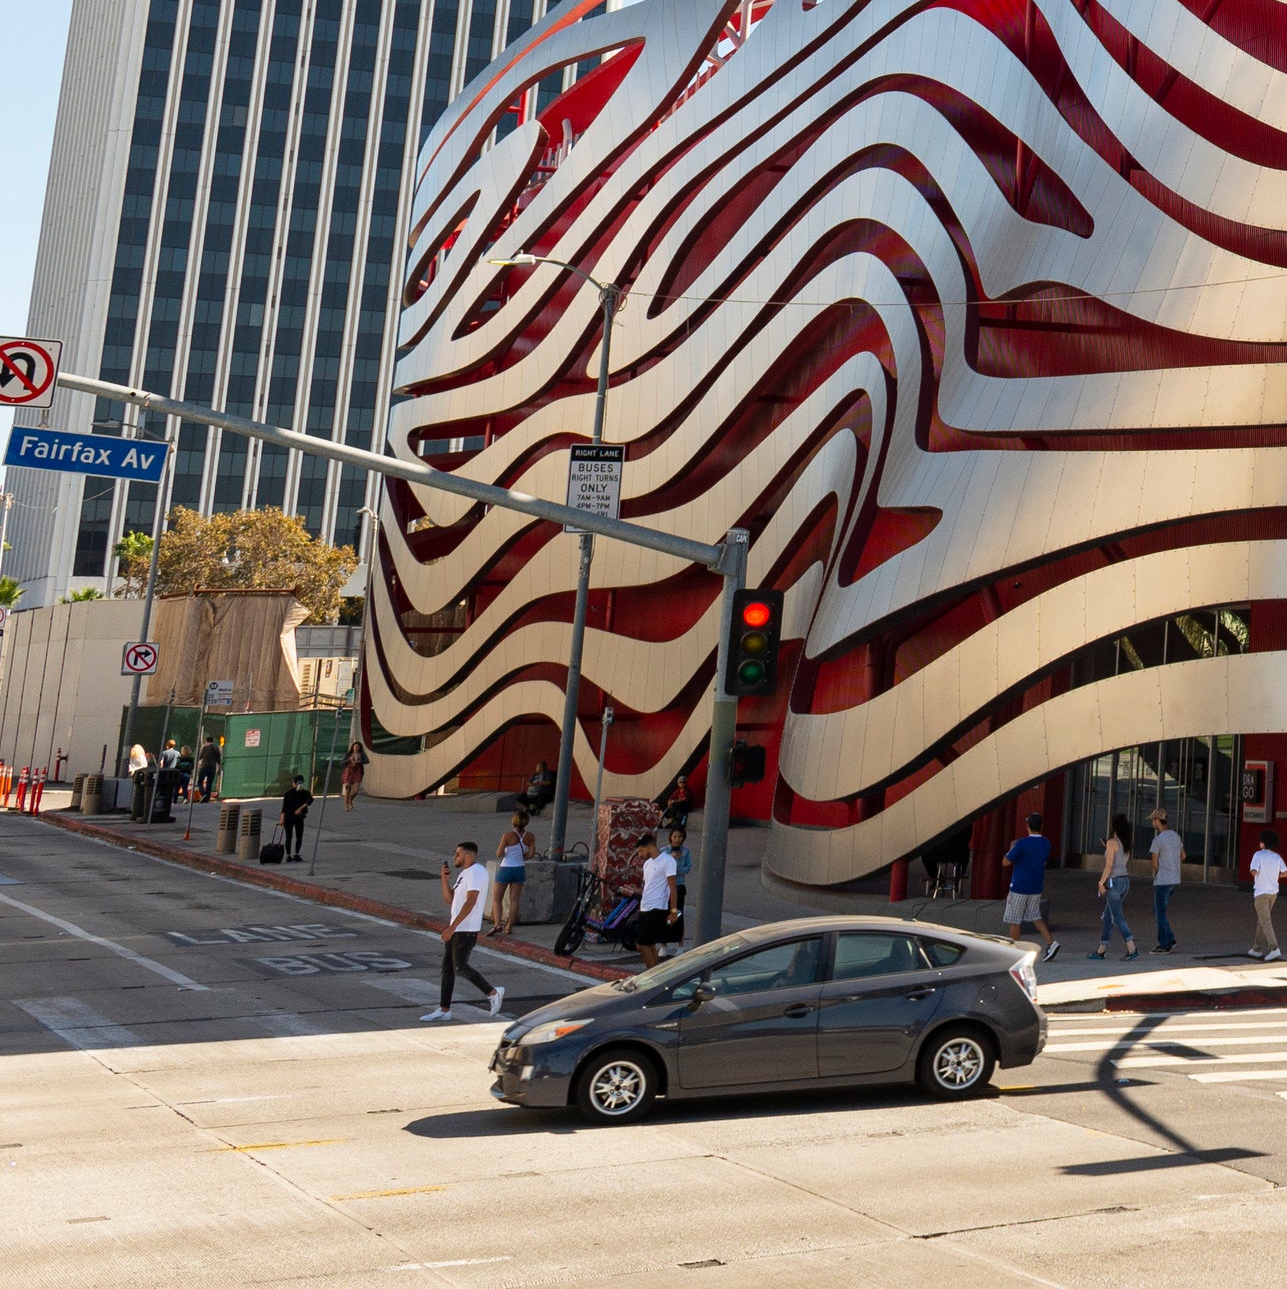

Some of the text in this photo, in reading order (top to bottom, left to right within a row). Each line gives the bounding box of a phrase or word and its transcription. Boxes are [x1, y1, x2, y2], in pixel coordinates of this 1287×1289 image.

[19, 435, 155, 470] Fairfax Av
[575, 449, 619, 458] RIGHT LANE
[578, 463, 614, 473] BUSES
[571, 473, 619, 482] RIGHT TURNS
[580, 483, 608, 493] ONLY
[1242, 773, 1255, 785] DRA
[1242, 786, 1255, 799] GO
[167, 923, 357, 945] LANE
[255, 951, 413, 976] BUS
